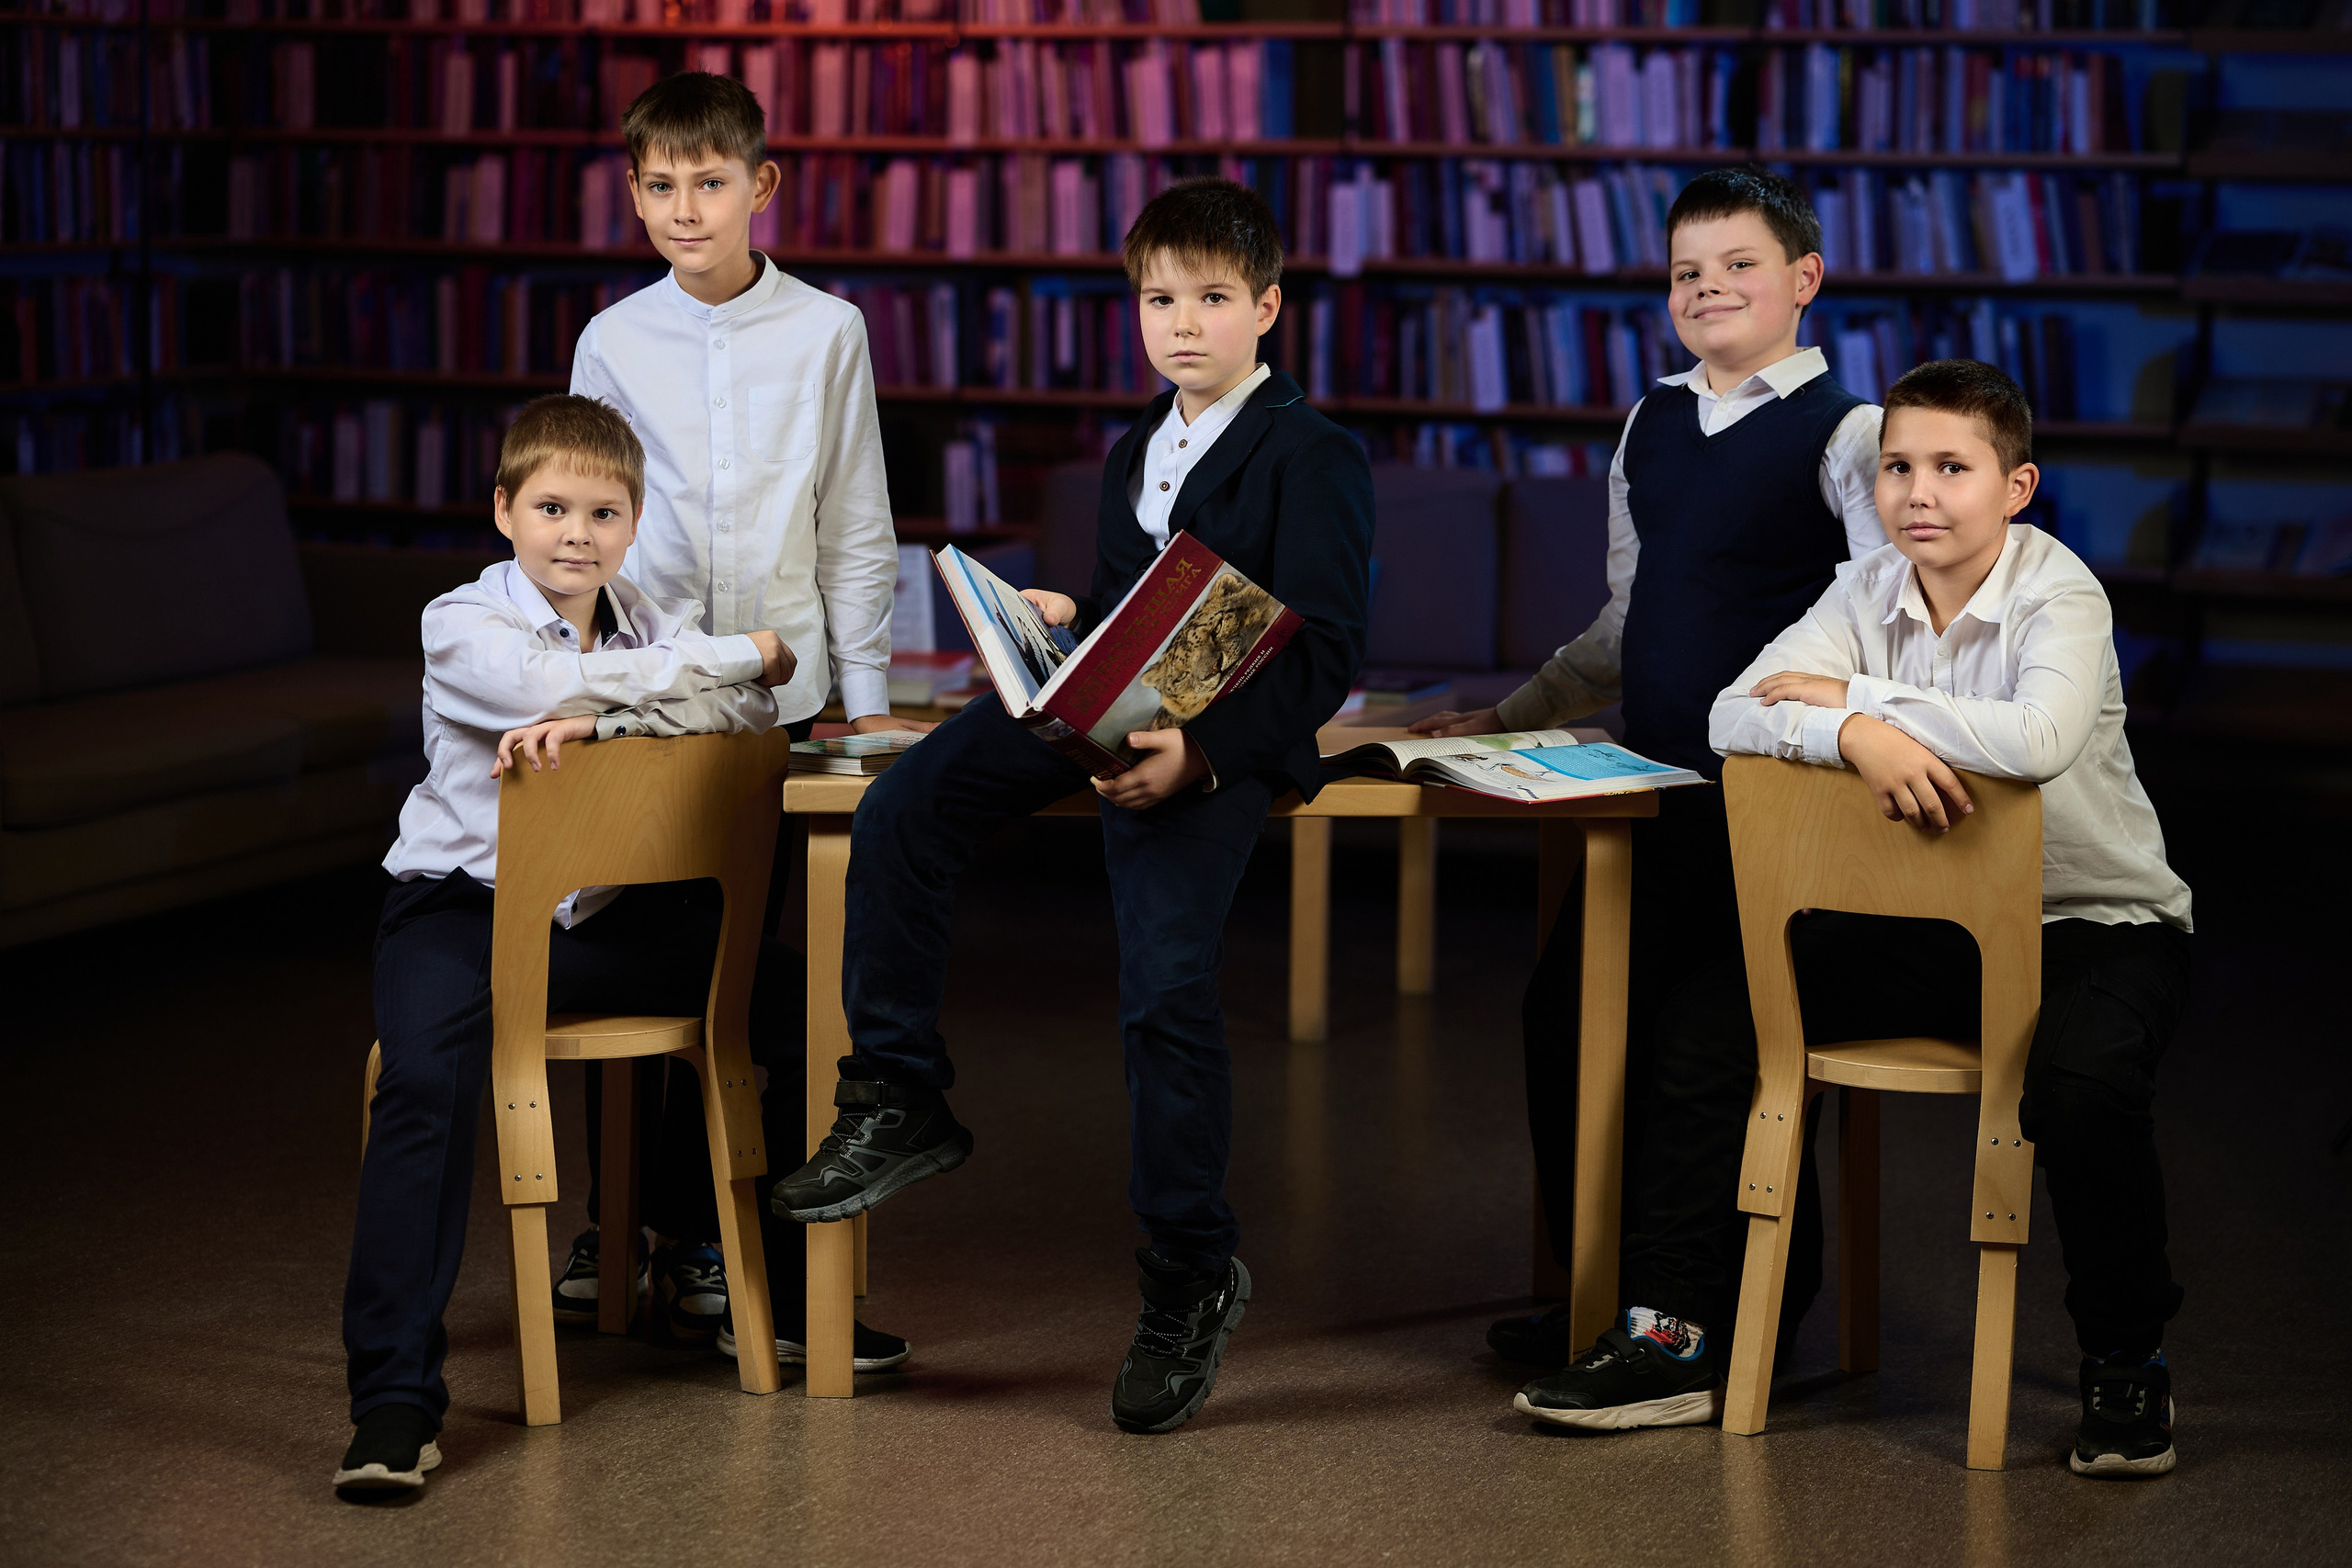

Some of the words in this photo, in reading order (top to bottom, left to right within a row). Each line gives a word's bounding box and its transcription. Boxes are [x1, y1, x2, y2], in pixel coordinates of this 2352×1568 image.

[1159, 567, 1202, 616] КНИГА
[1093, 557, 1193, 675] БОЛЬШАЯ
[1228, 676, 1245, 694] ЕЧЕНЬ
[1244, 655, 1261, 675] РЕДКИХ
[1255, 647, 1273, 669] РОССИИ
